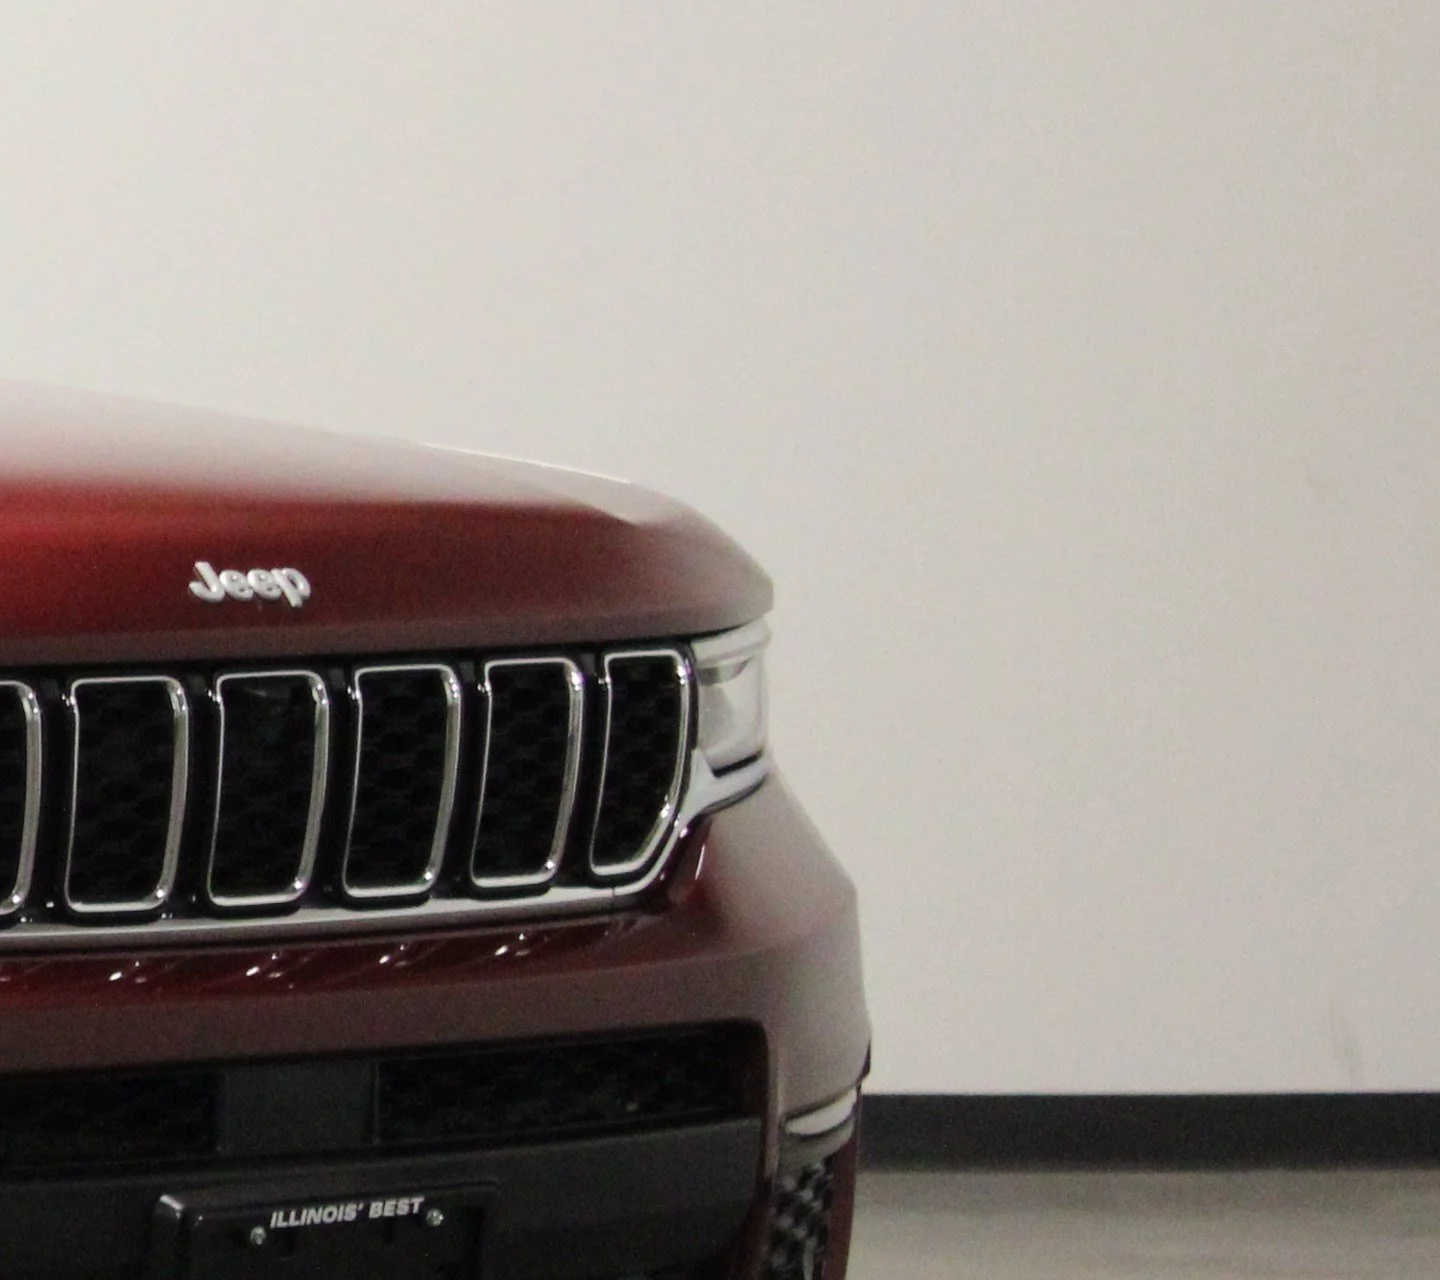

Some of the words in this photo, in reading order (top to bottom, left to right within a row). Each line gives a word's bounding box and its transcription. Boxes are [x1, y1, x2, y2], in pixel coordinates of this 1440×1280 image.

[187, 560, 312, 608] Jeep
[269, 1202, 364, 1230] ILLINOIS'
[367, 1195, 426, 1220] BEST
